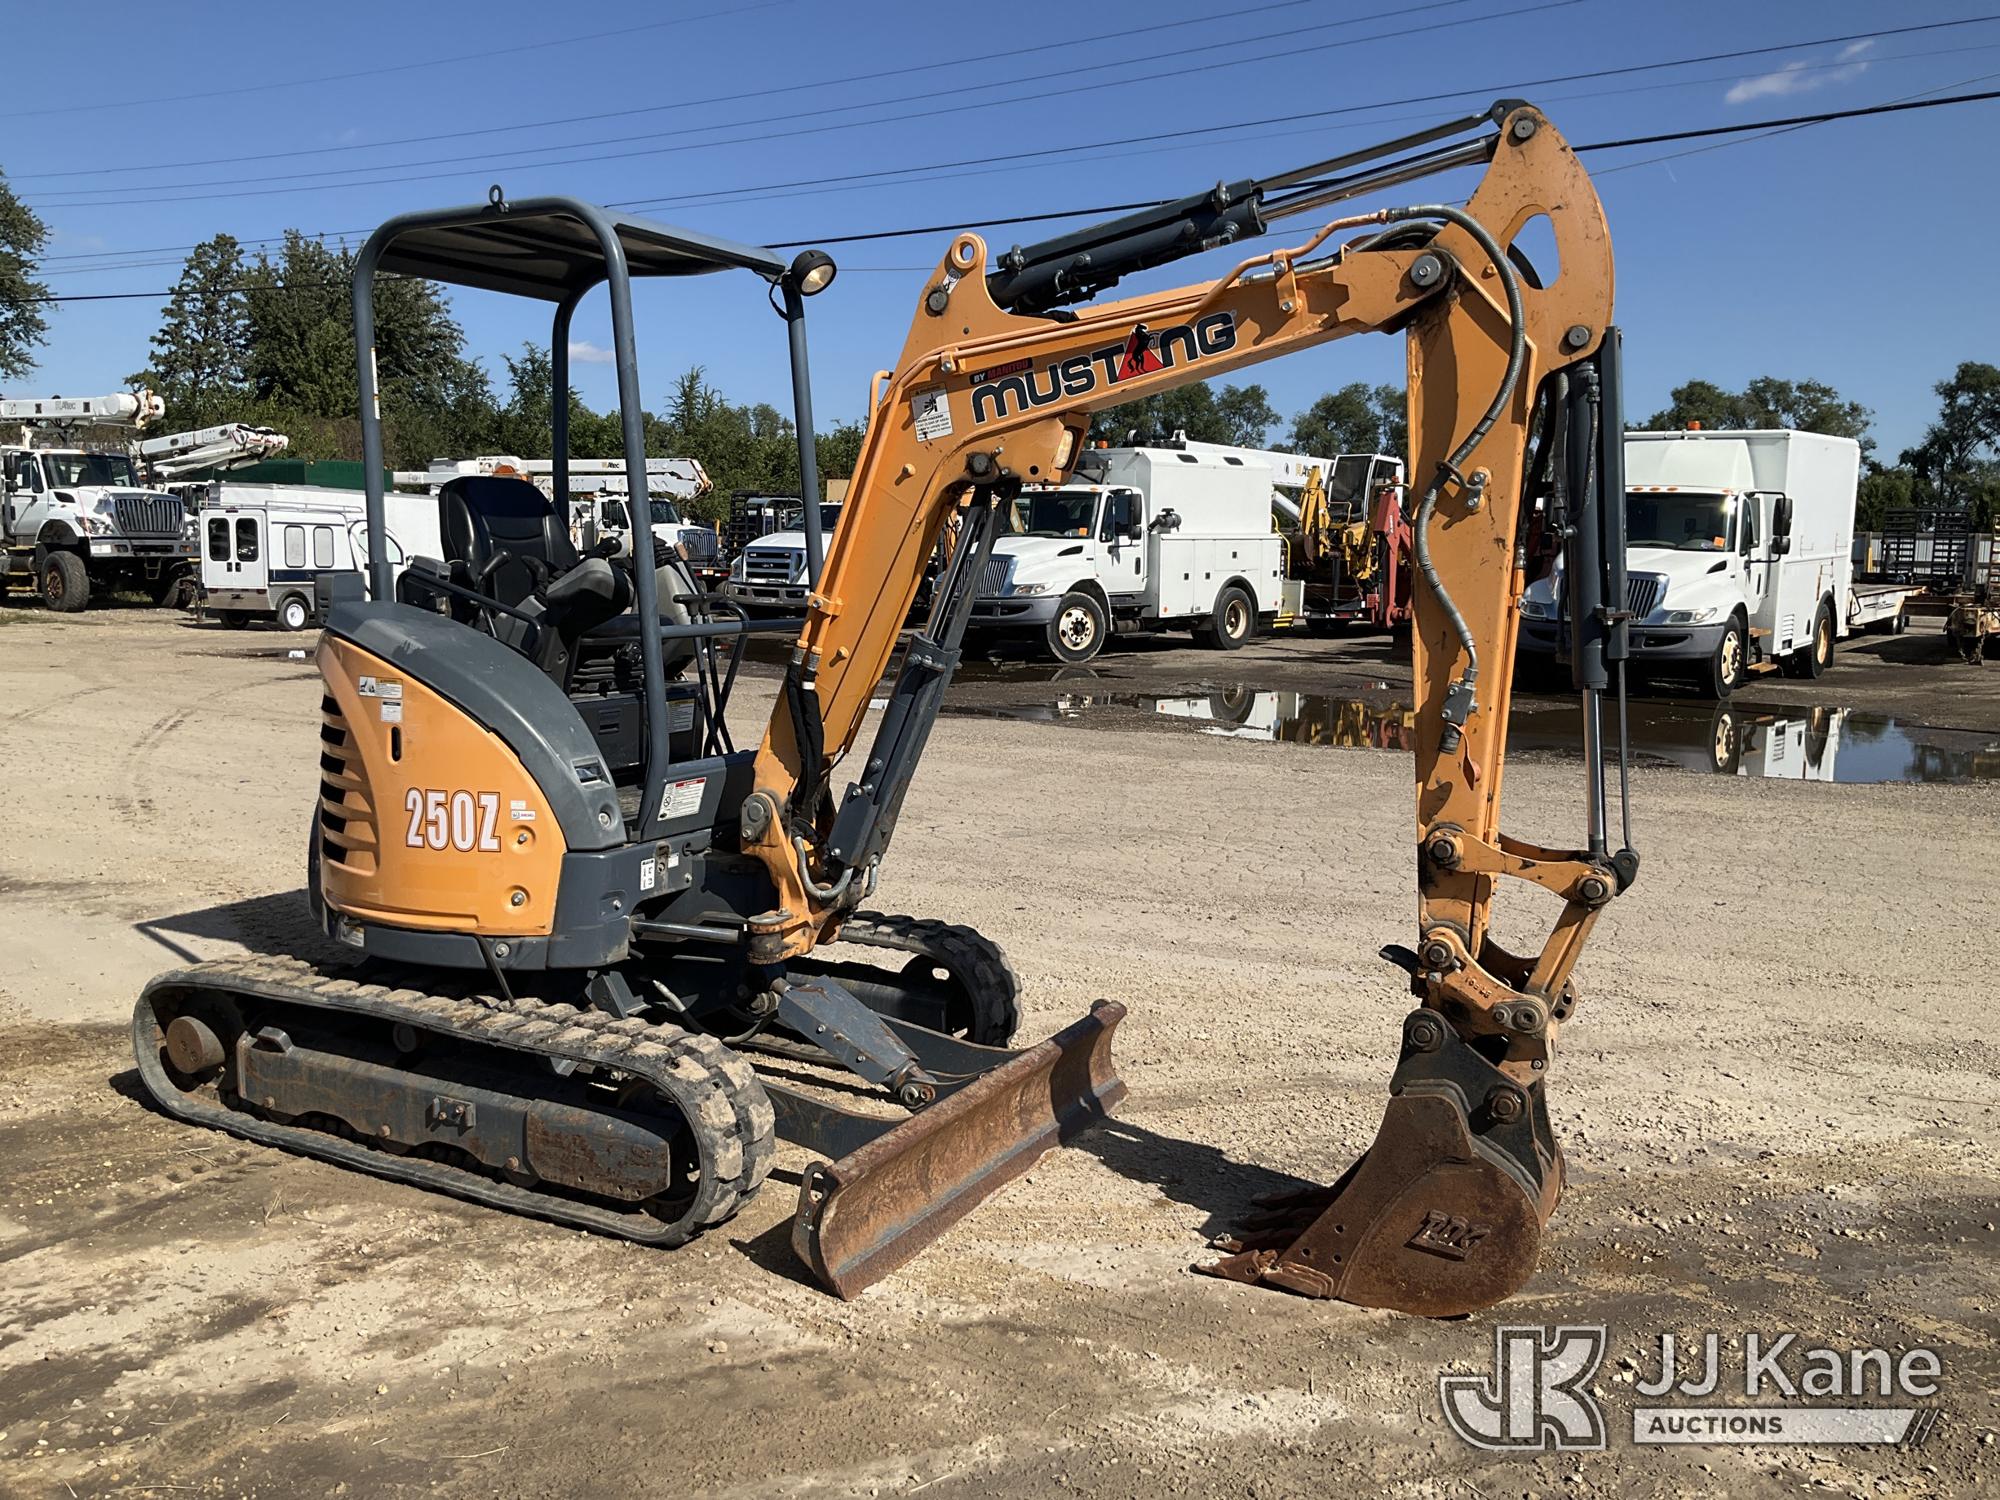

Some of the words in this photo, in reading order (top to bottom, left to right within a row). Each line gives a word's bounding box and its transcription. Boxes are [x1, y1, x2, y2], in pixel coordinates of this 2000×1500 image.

[970, 311, 1238, 425] MUSTANG
[973, 371, 986, 384] BY
[987, 358, 1029, 379] MANITOU
[404, 787, 502, 853] 250Z
